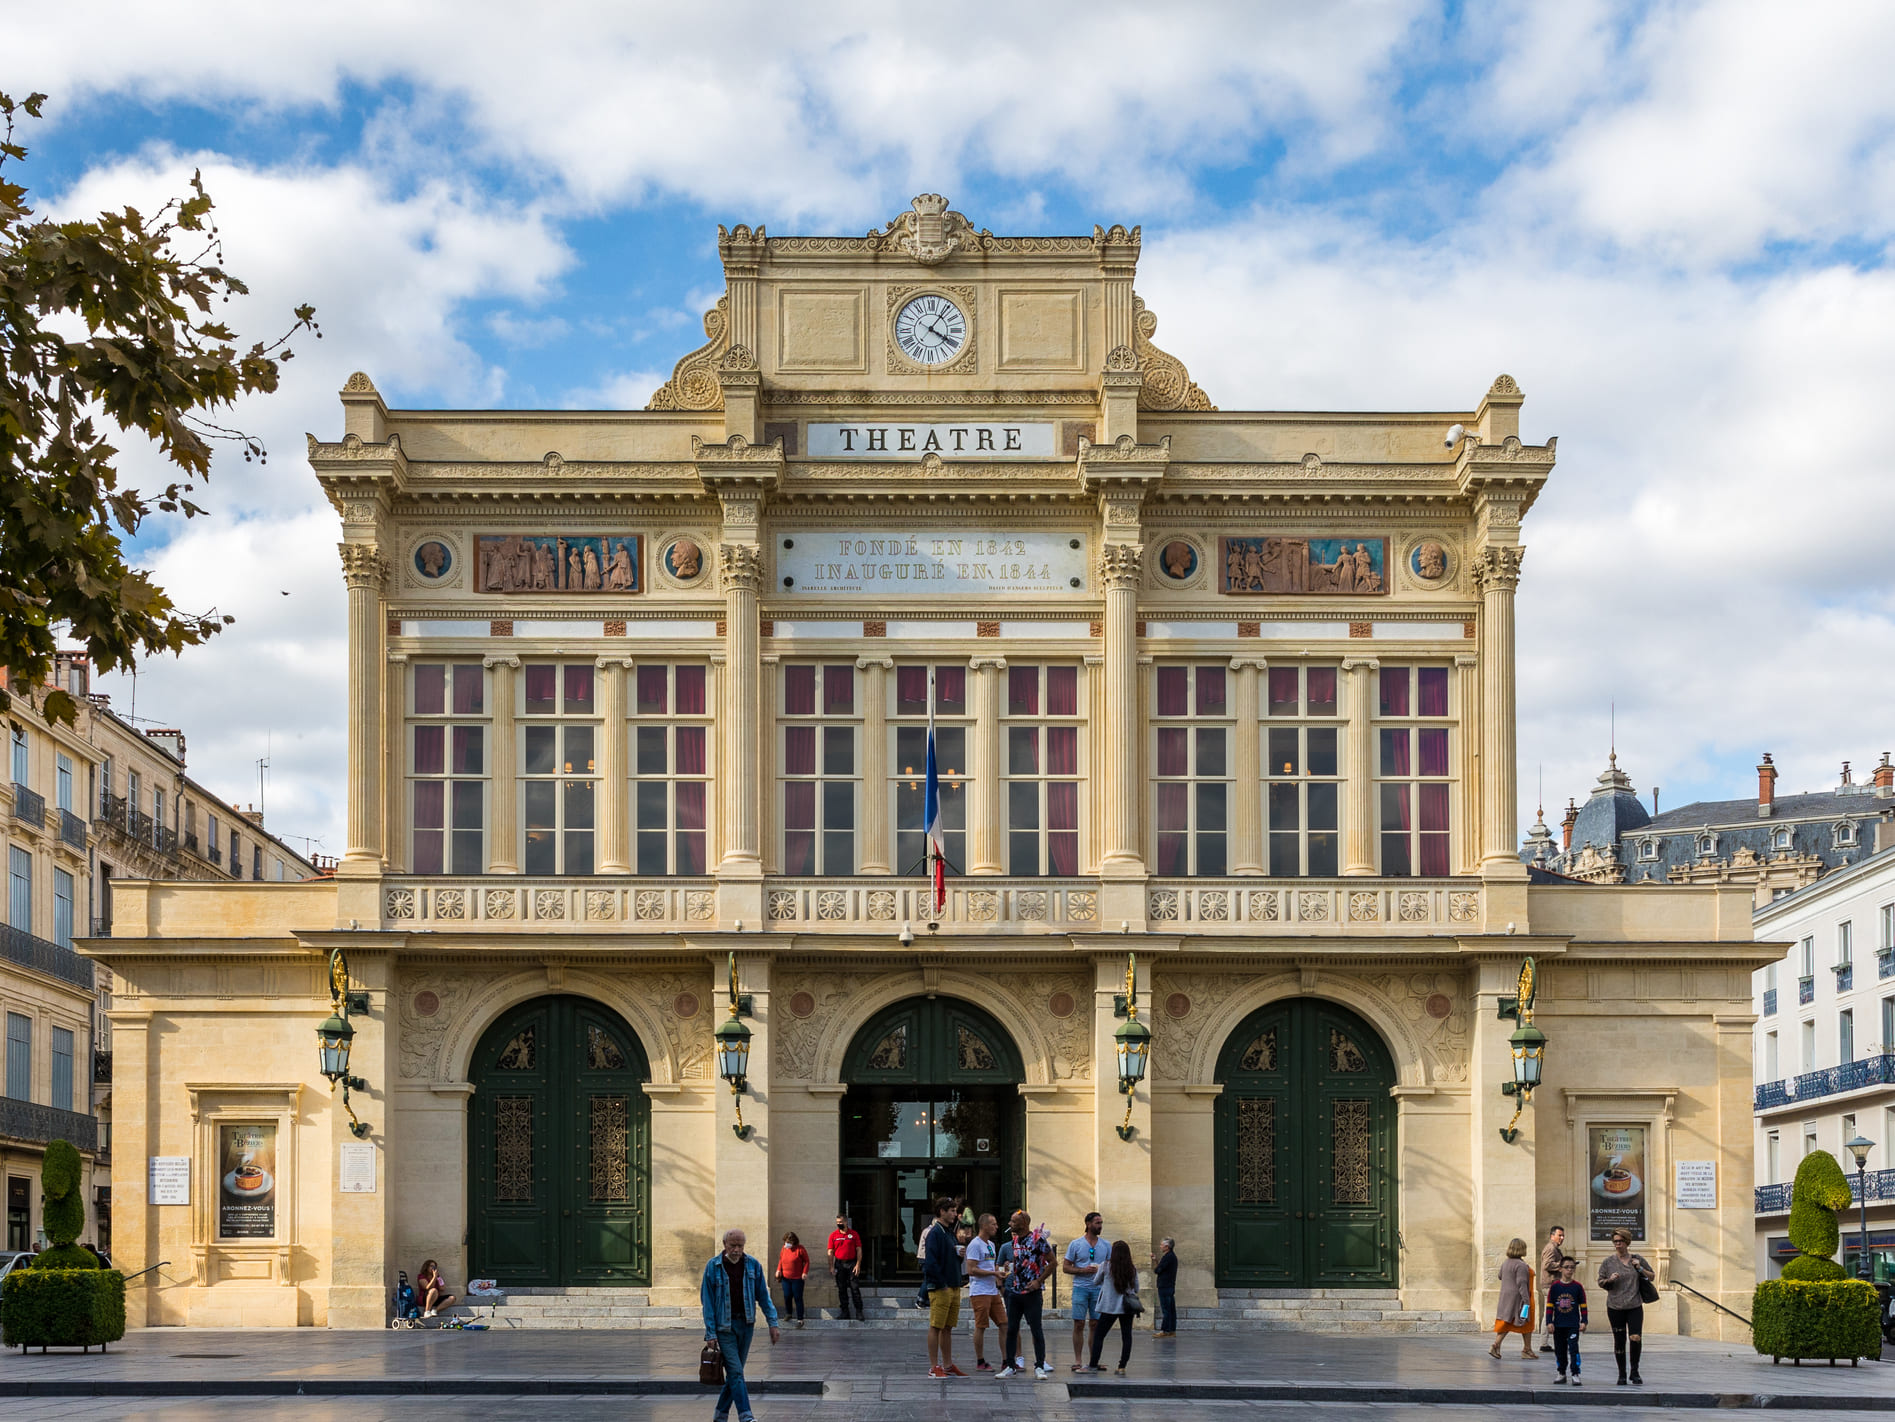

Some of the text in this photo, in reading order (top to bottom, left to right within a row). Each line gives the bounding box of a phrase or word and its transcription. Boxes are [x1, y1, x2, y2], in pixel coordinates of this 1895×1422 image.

[839, 428, 1022, 452] THEATRE
[839, 535, 1026, 556] FONDÉ EN 1842
[814, 558, 1050, 580] INAUGURÉ EN 1844
